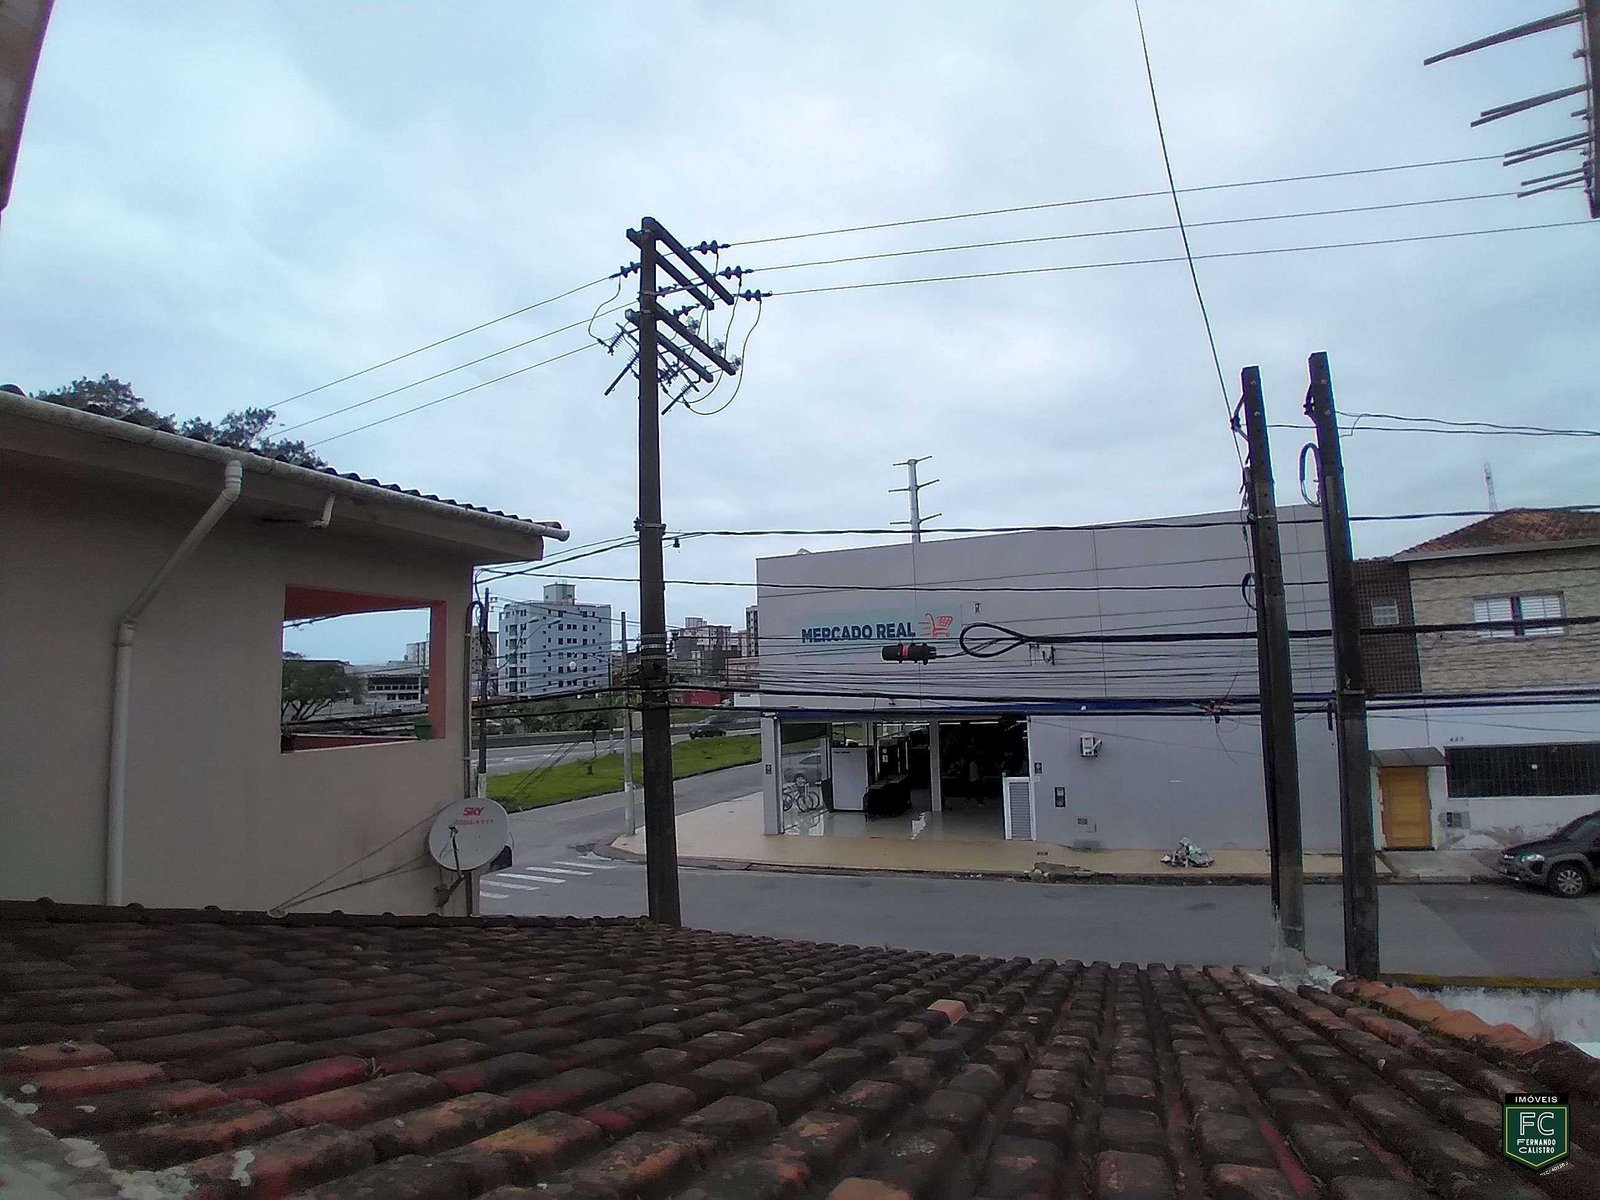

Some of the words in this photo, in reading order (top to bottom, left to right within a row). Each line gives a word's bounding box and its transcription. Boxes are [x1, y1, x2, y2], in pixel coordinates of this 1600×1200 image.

[801, 624, 872, 643] MERCADO
[876, 621, 916, 639] REAL
[463, 806, 485, 816] SKY
